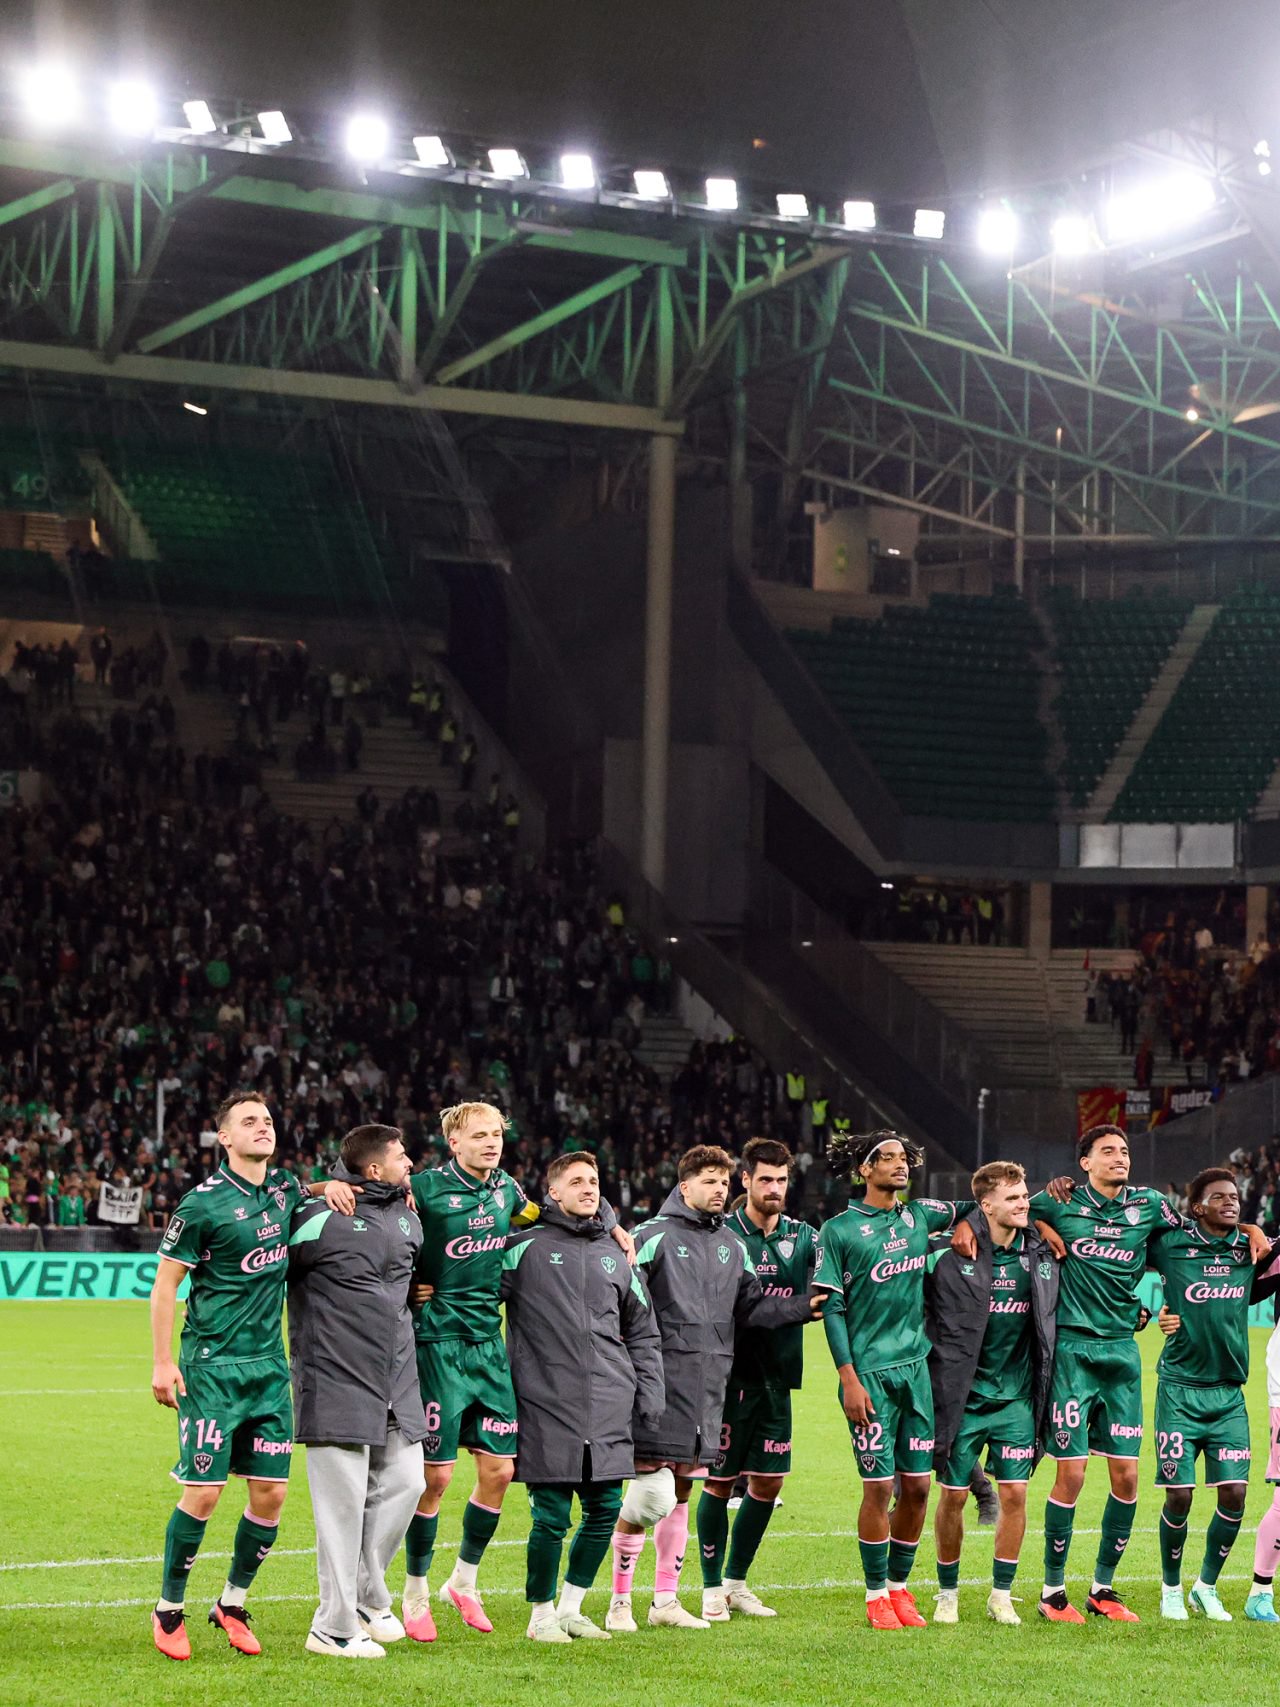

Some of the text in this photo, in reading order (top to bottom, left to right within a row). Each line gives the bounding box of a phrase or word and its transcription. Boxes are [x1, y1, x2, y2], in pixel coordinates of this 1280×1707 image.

[256, 1223, 281, 1237] Loire
[468, 1215, 495, 1226] Loire
[1094, 1225, 1122, 1236] Loire
[445, 1233, 507, 1259] Casino
[883, 1238, 908, 1250] Loire
[1071, 1237, 1134, 1263] Casino
[240, 1243, 288, 1273] Casin
[756, 1264, 778, 1272] oire
[870, 1254, 926, 1283] Casino
[1203, 1265, 1231, 1273] Loire
[0, 1261, 158, 1298] VERTS
[1184, 1281, 1245, 1304] Casino
[989, 1296, 1030, 1313] sino
[425, 1401, 441, 1432] 6
[1053, 1400, 1081, 1429] 46
[195, 1418, 224, 1451] 14
[854, 1422, 884, 1451] 32
[1159, 1431, 1184, 1459] 23
